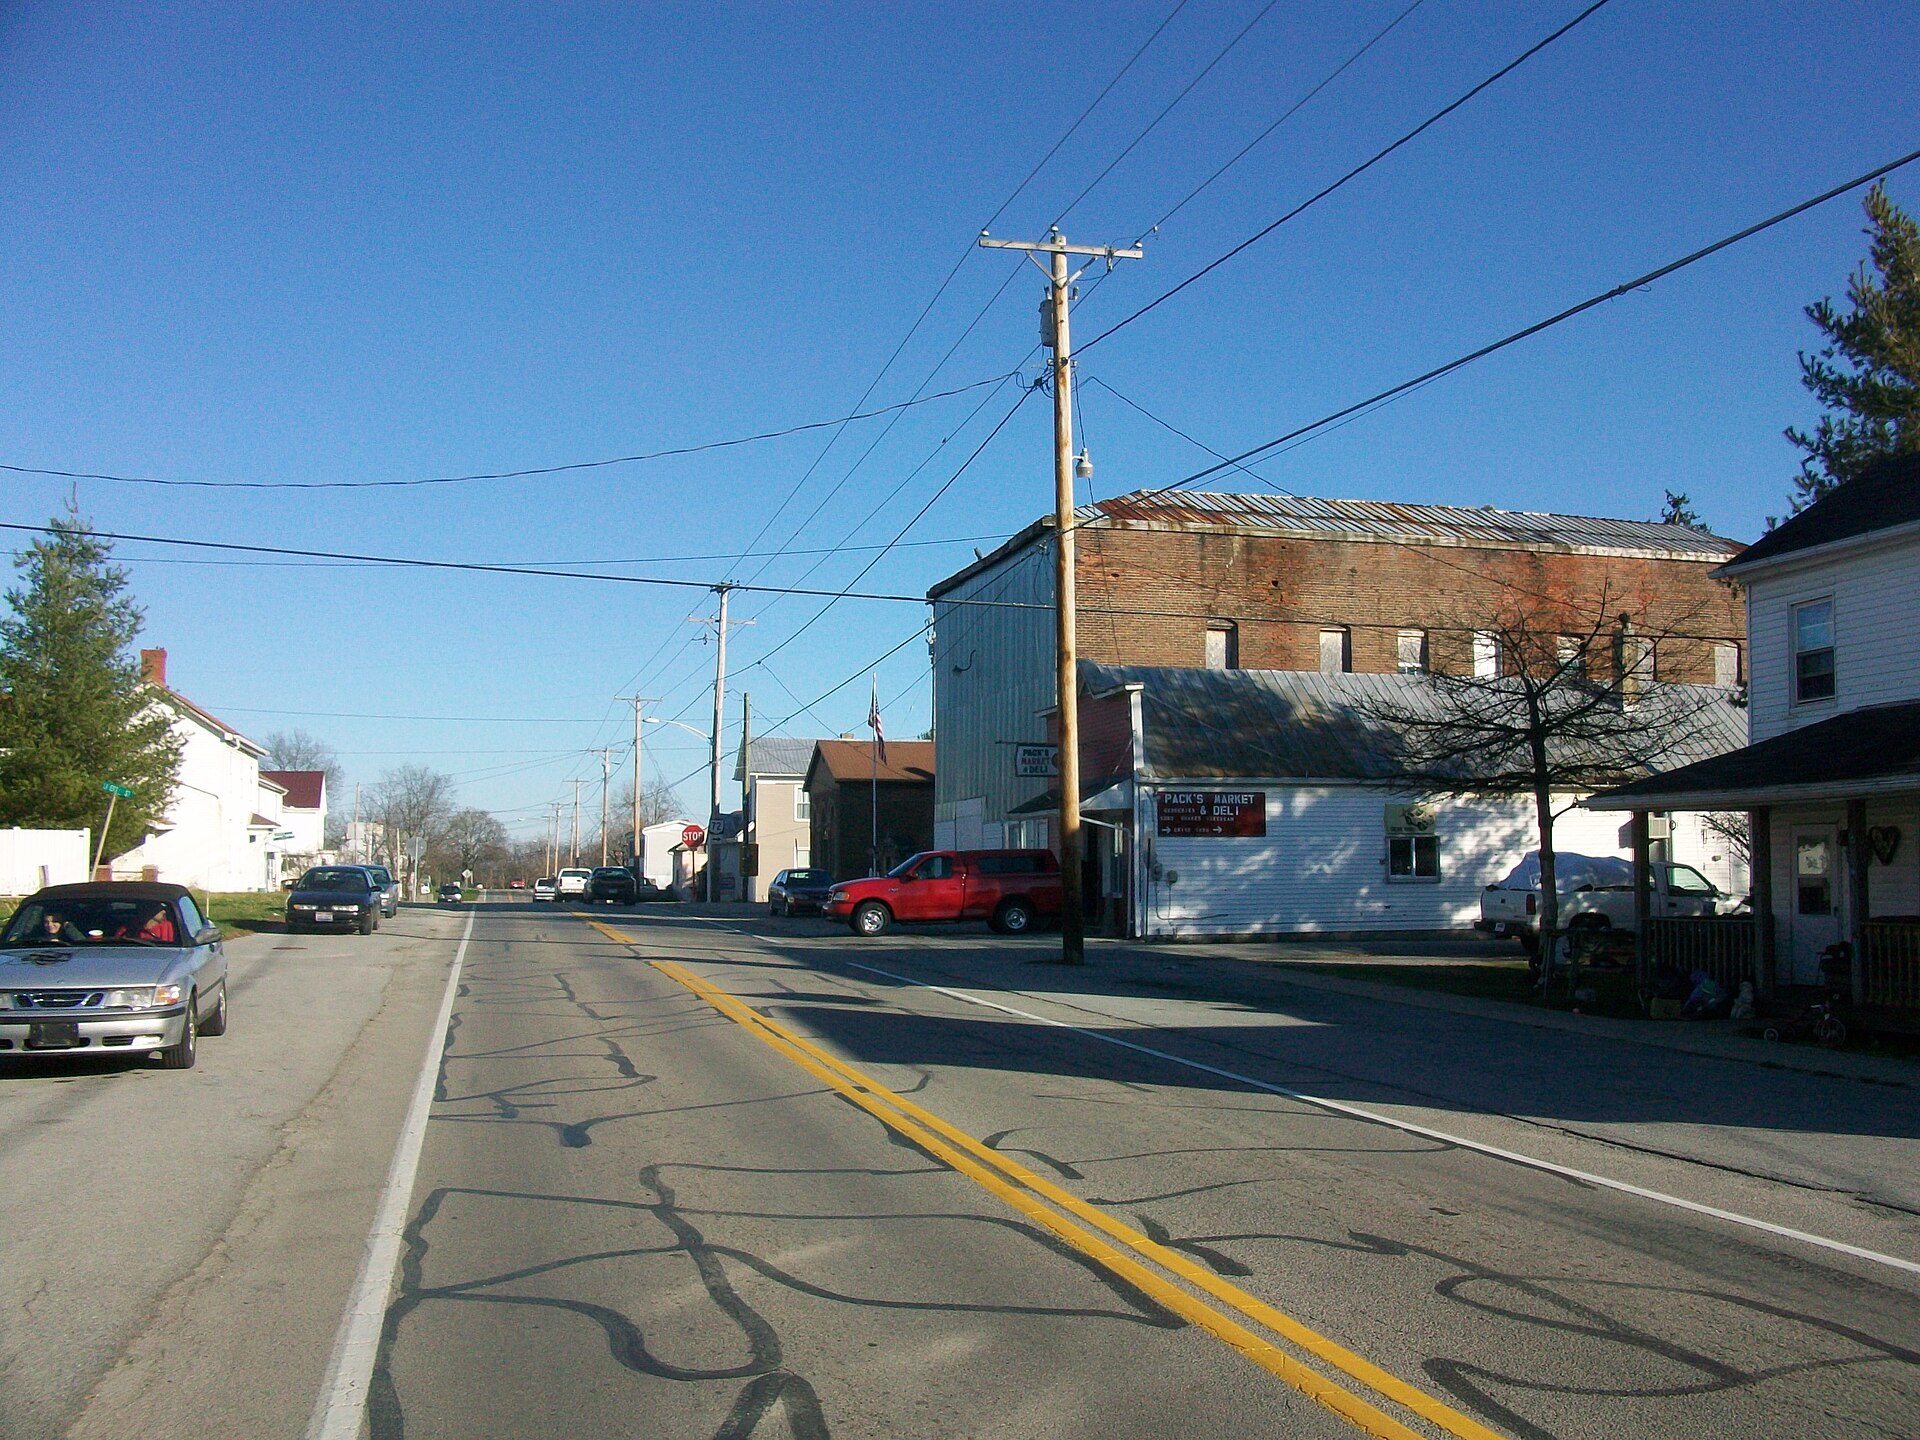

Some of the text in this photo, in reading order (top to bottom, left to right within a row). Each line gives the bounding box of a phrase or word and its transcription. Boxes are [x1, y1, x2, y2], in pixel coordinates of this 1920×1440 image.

[1021, 757, 1050, 765] MARKET
[1029, 765, 1048, 773] DELI
[1164, 793, 1255, 804] PACK'S MARKET
[1200, 805, 1239, 815] & DELI
[712, 822, 722, 830] 72
[683, 832, 704, 841] STOP
